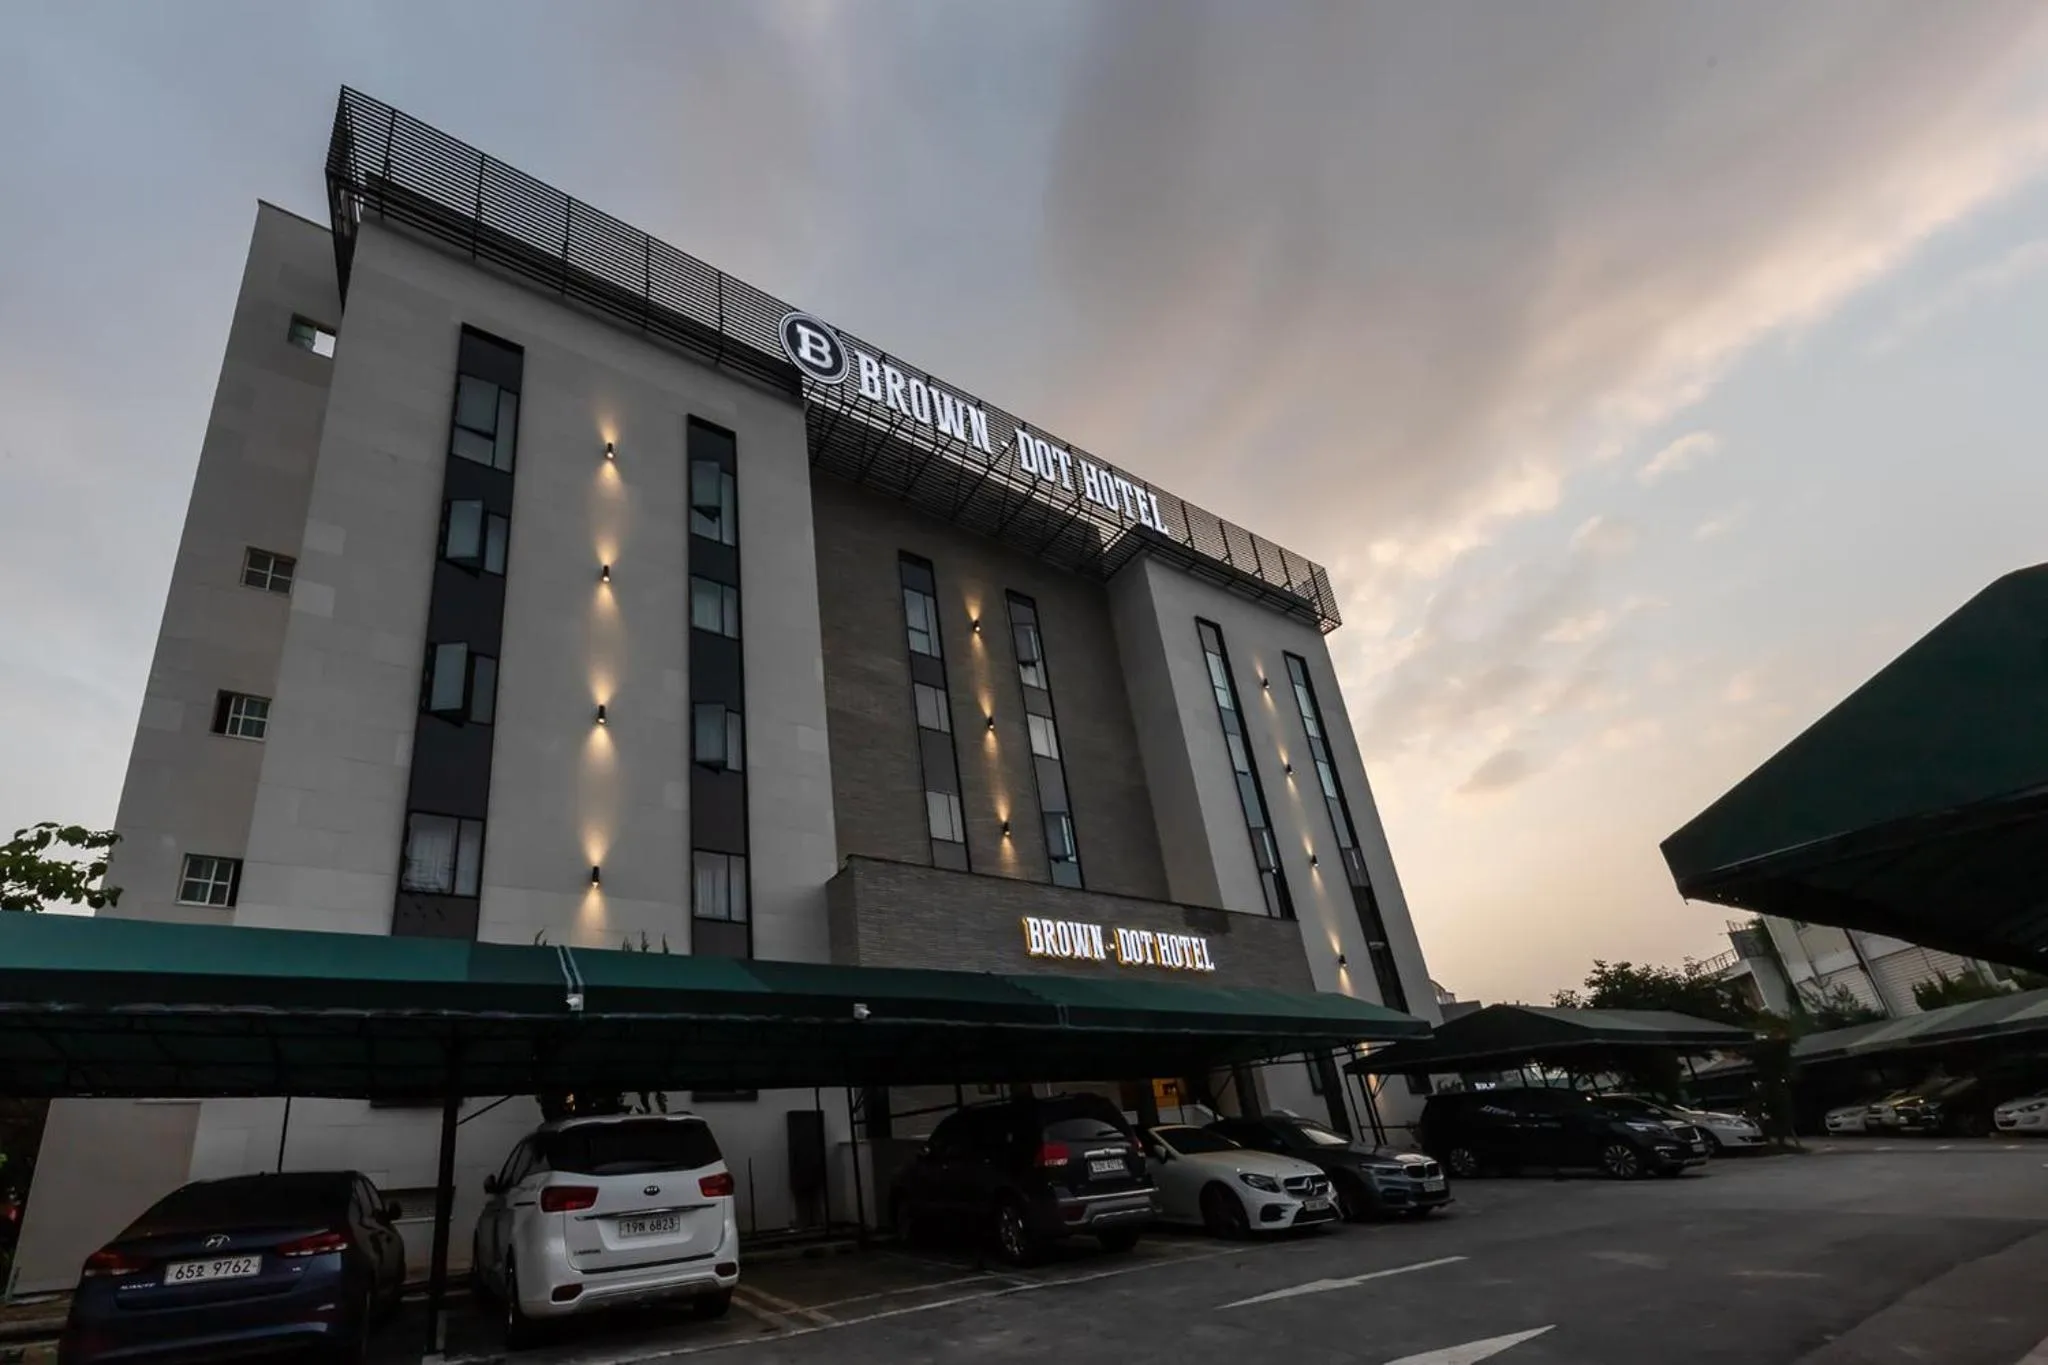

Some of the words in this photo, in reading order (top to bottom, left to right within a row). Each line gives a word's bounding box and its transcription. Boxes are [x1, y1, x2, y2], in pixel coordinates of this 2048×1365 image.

[796, 323, 834, 369] B
[854, 349, 993, 454] BROWN
[1014, 427, 1072, 491] DOT
[1079, 459, 1169, 534] HOTEL
[1023, 917, 1106, 961] BROWN
[1115, 927, 1154, 966] DOT
[1154, 932, 1215, 972] HOTEL
[213, 1258, 252, 1276] 9762
